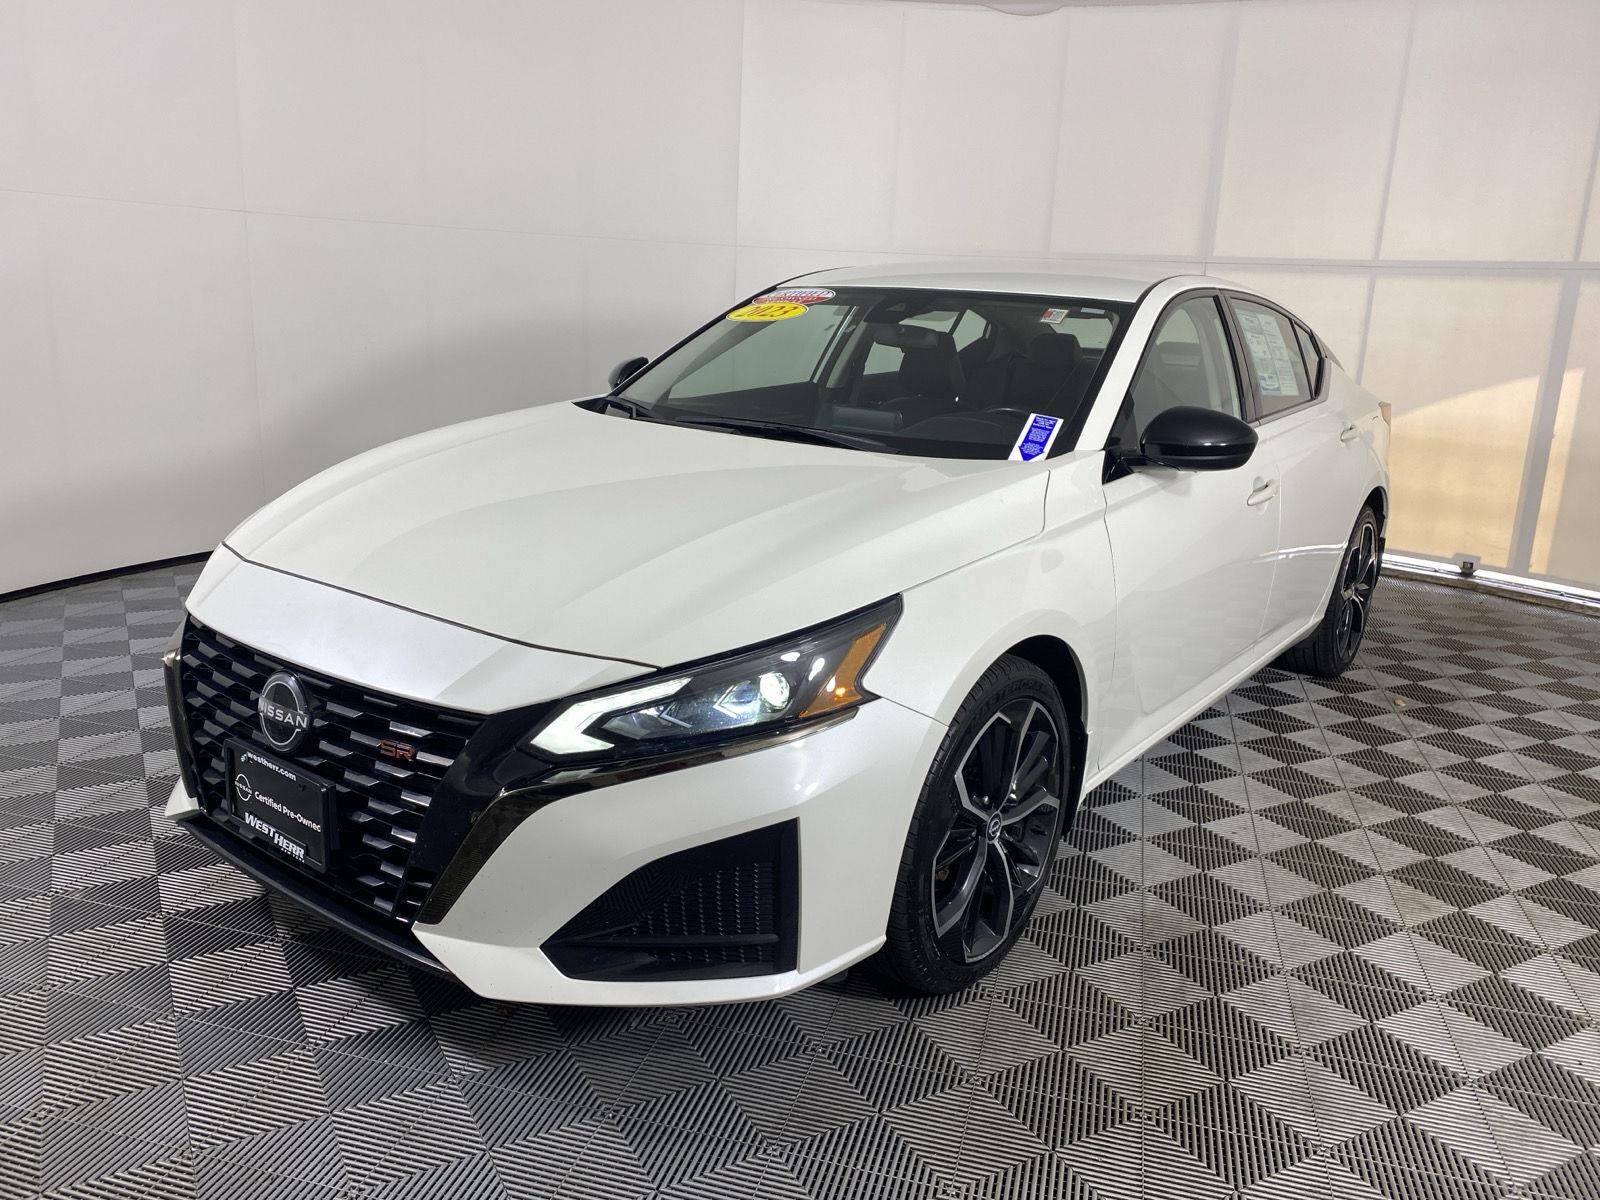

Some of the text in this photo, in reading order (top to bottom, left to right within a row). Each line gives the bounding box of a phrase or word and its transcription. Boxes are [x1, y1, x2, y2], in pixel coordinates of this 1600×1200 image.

[734, 305, 801, 318] 2023
[259, 700, 308, 729] NISSAN
[380, 740, 414, 761] SR
[246, 751, 297, 781] westherr.com
[254, 791, 282, 812] Certified
